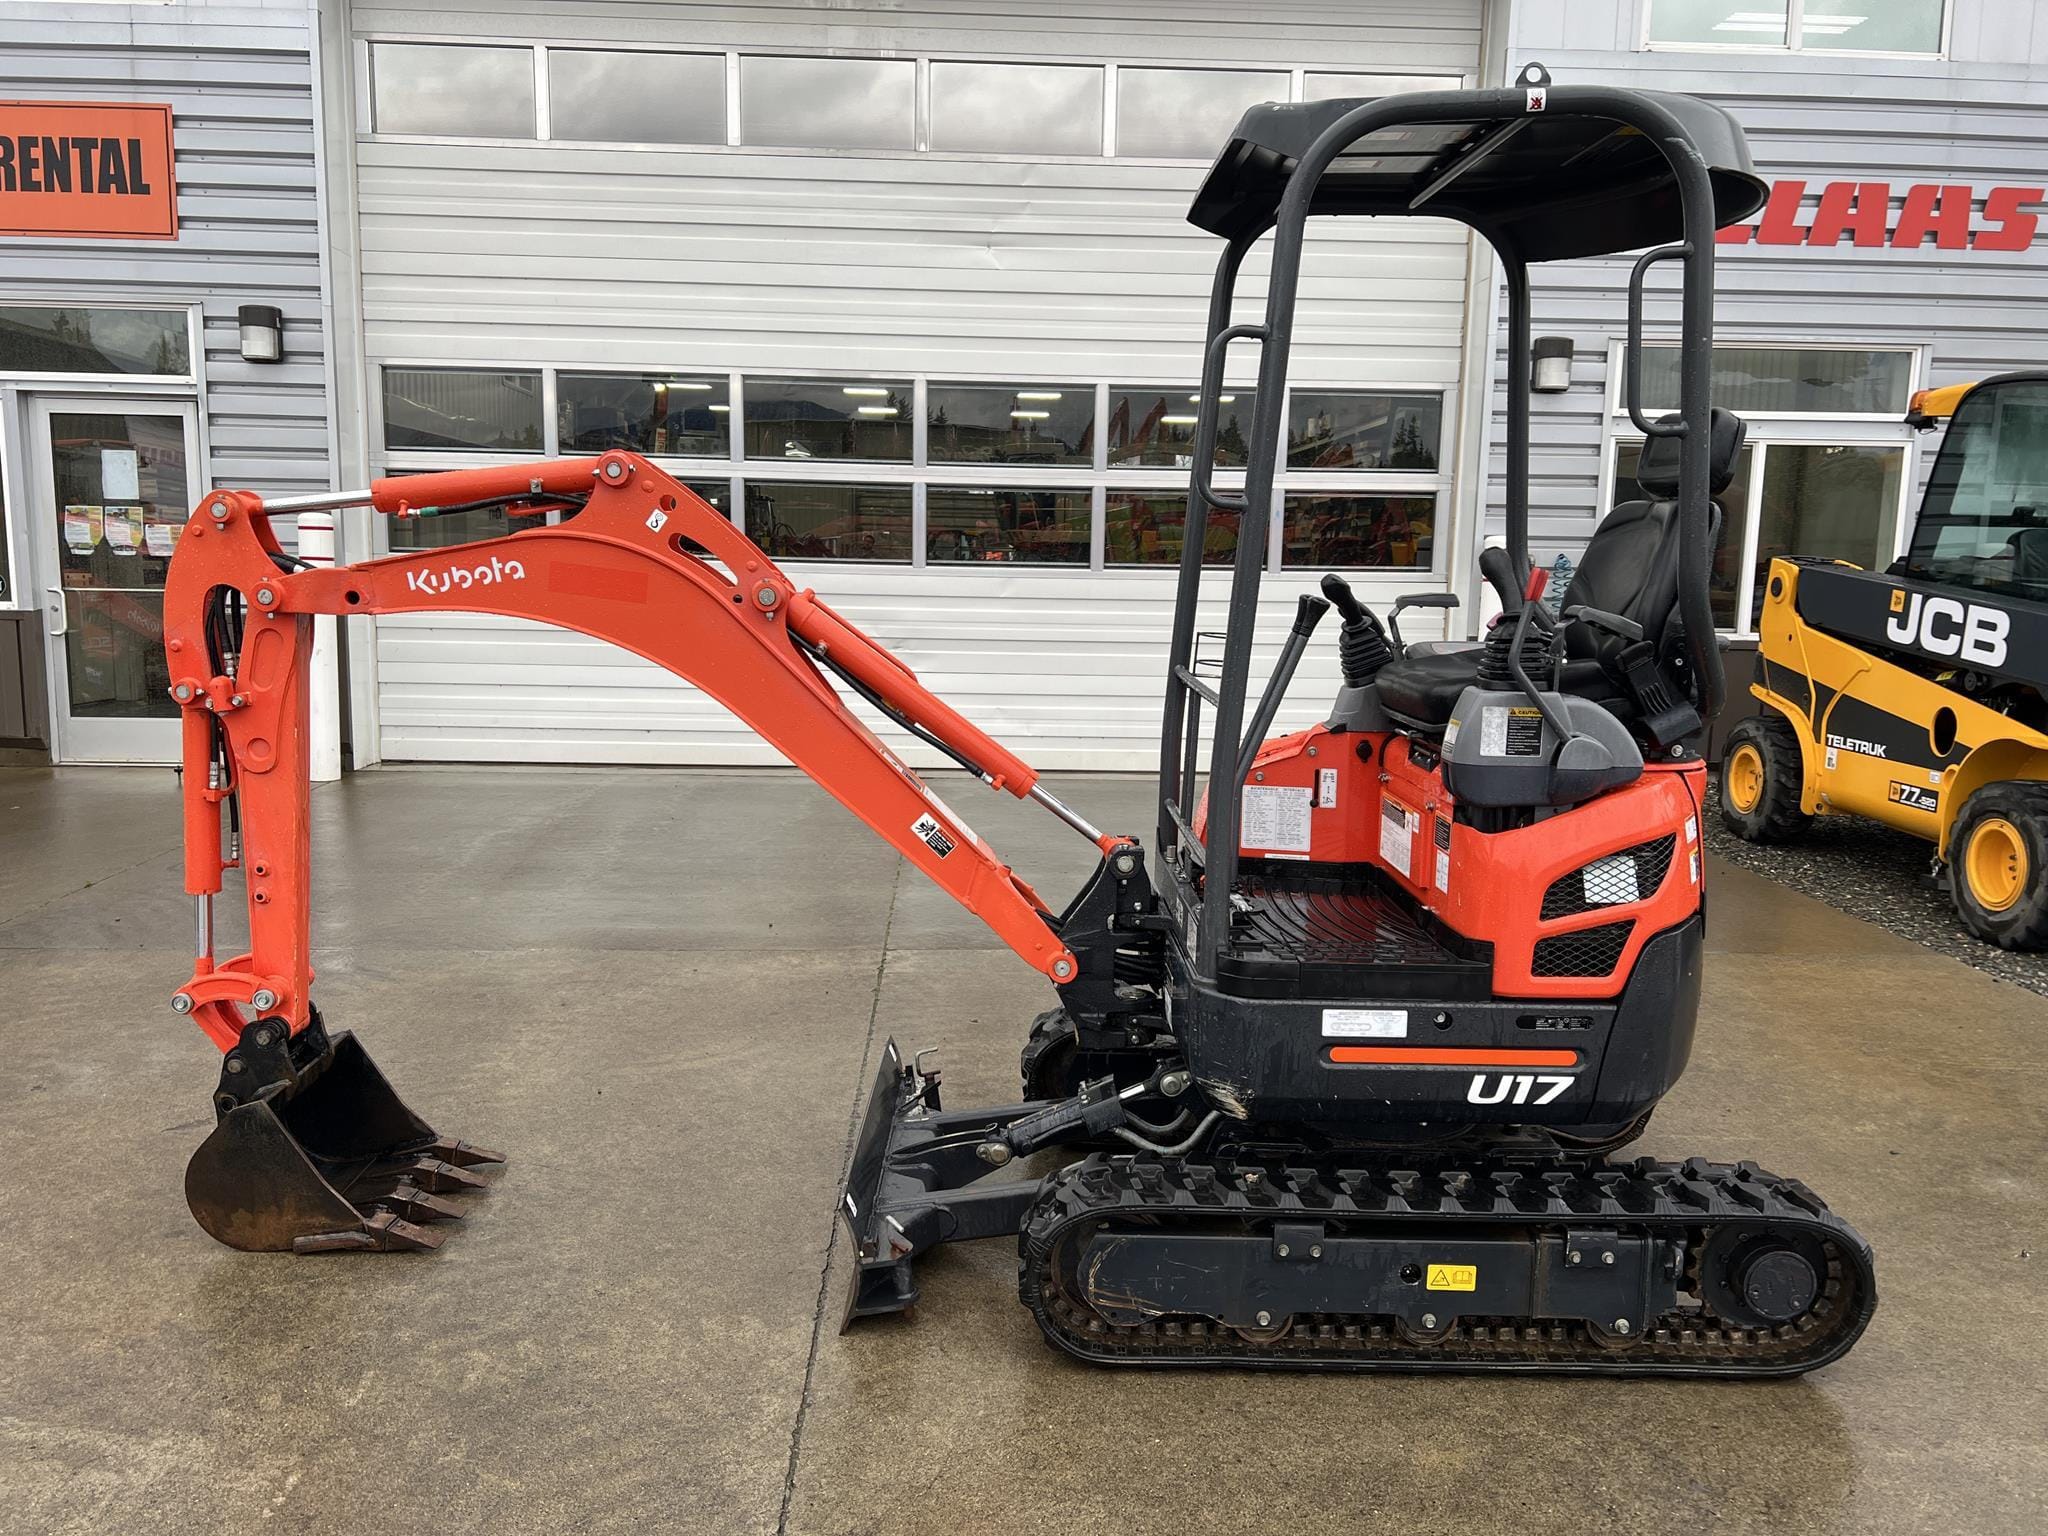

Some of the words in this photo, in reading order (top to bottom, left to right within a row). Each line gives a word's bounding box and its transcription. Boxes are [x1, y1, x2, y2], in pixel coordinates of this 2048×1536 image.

[0, 136, 150, 194] RENTAL
[407, 557, 525, 594] Kubota
[1887, 593, 2010, 667] JCB
[1826, 734, 1887, 758] TELETRUK
[1467, 1075, 1575, 1104] U17
